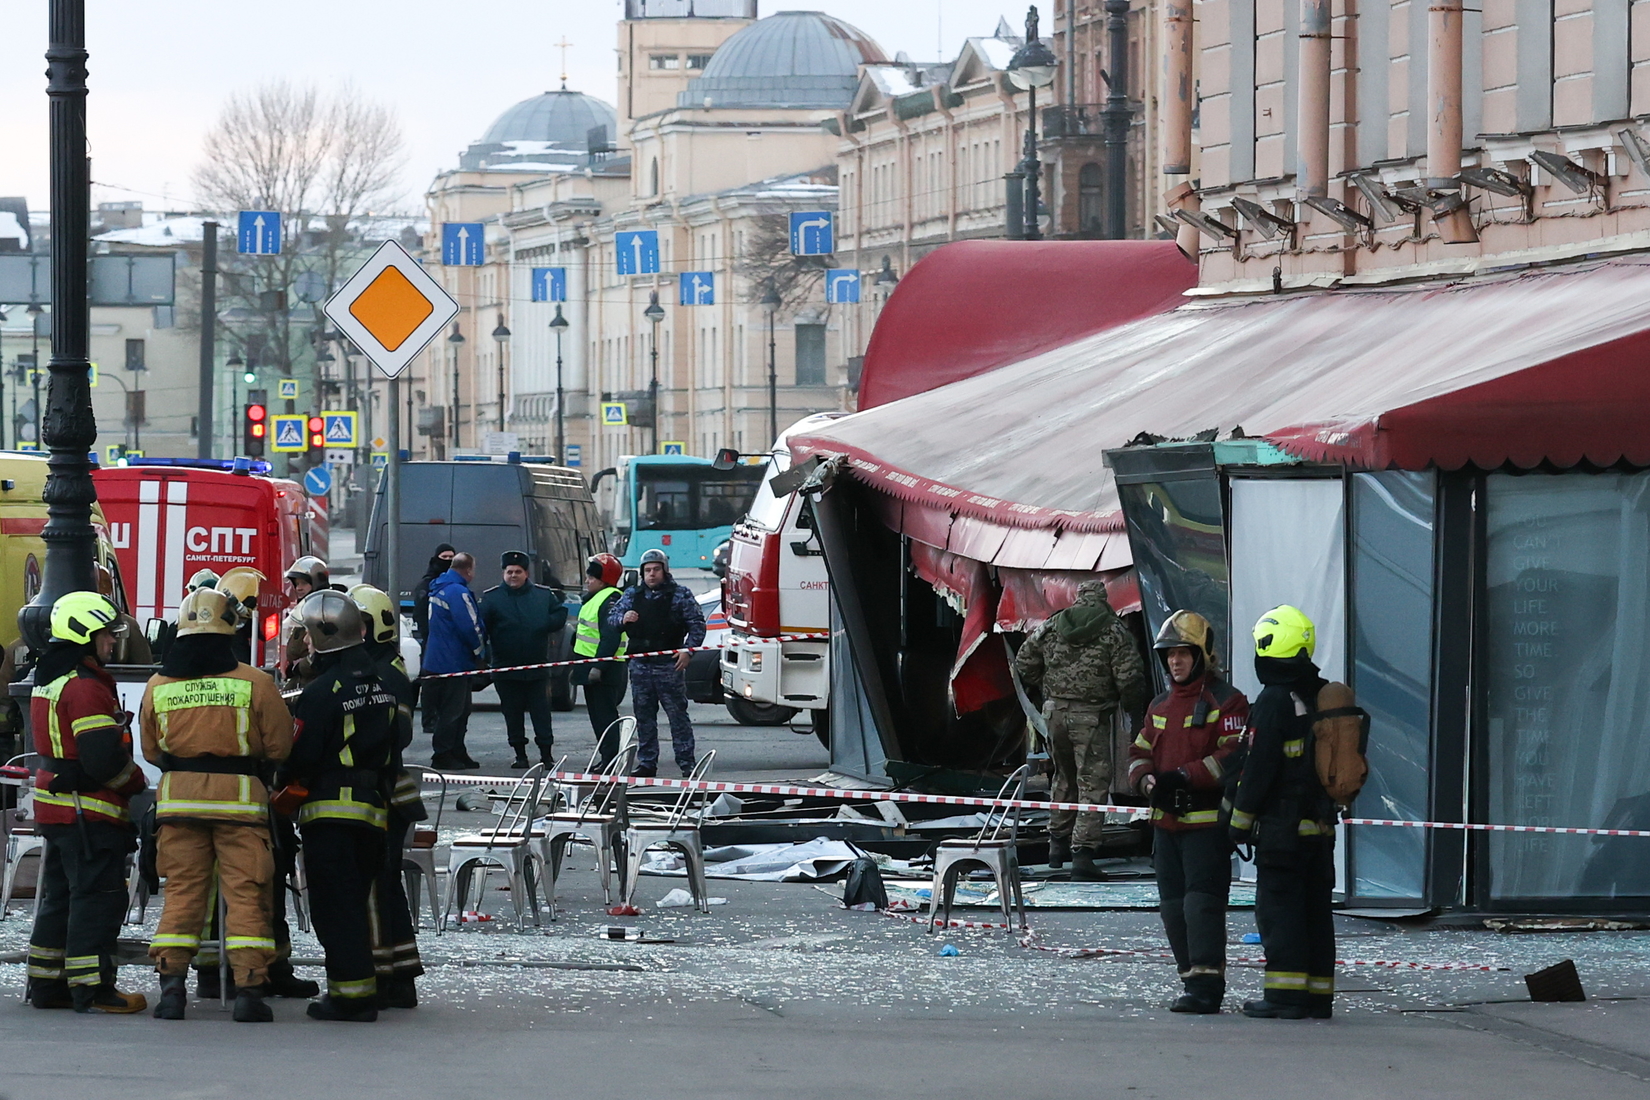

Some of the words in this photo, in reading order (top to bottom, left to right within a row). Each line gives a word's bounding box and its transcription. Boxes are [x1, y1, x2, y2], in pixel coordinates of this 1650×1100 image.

[186, 526, 257, 554] СПТ
[186, 554, 256, 563] САНКТ-ПЕТЕРБУРГ
[1515, 577, 1559, 592] YOUR
[261, 593, 282, 608] ШТАБ
[1514, 599, 1548, 614] LIFE
[1513, 620, 1559, 636] MORE
[1515, 664, 1535, 679] SO
[185, 682, 218, 692] СЛУЖБА
[1514, 686, 1552, 701] GIVE
[1515, 708, 1547, 722] THE
